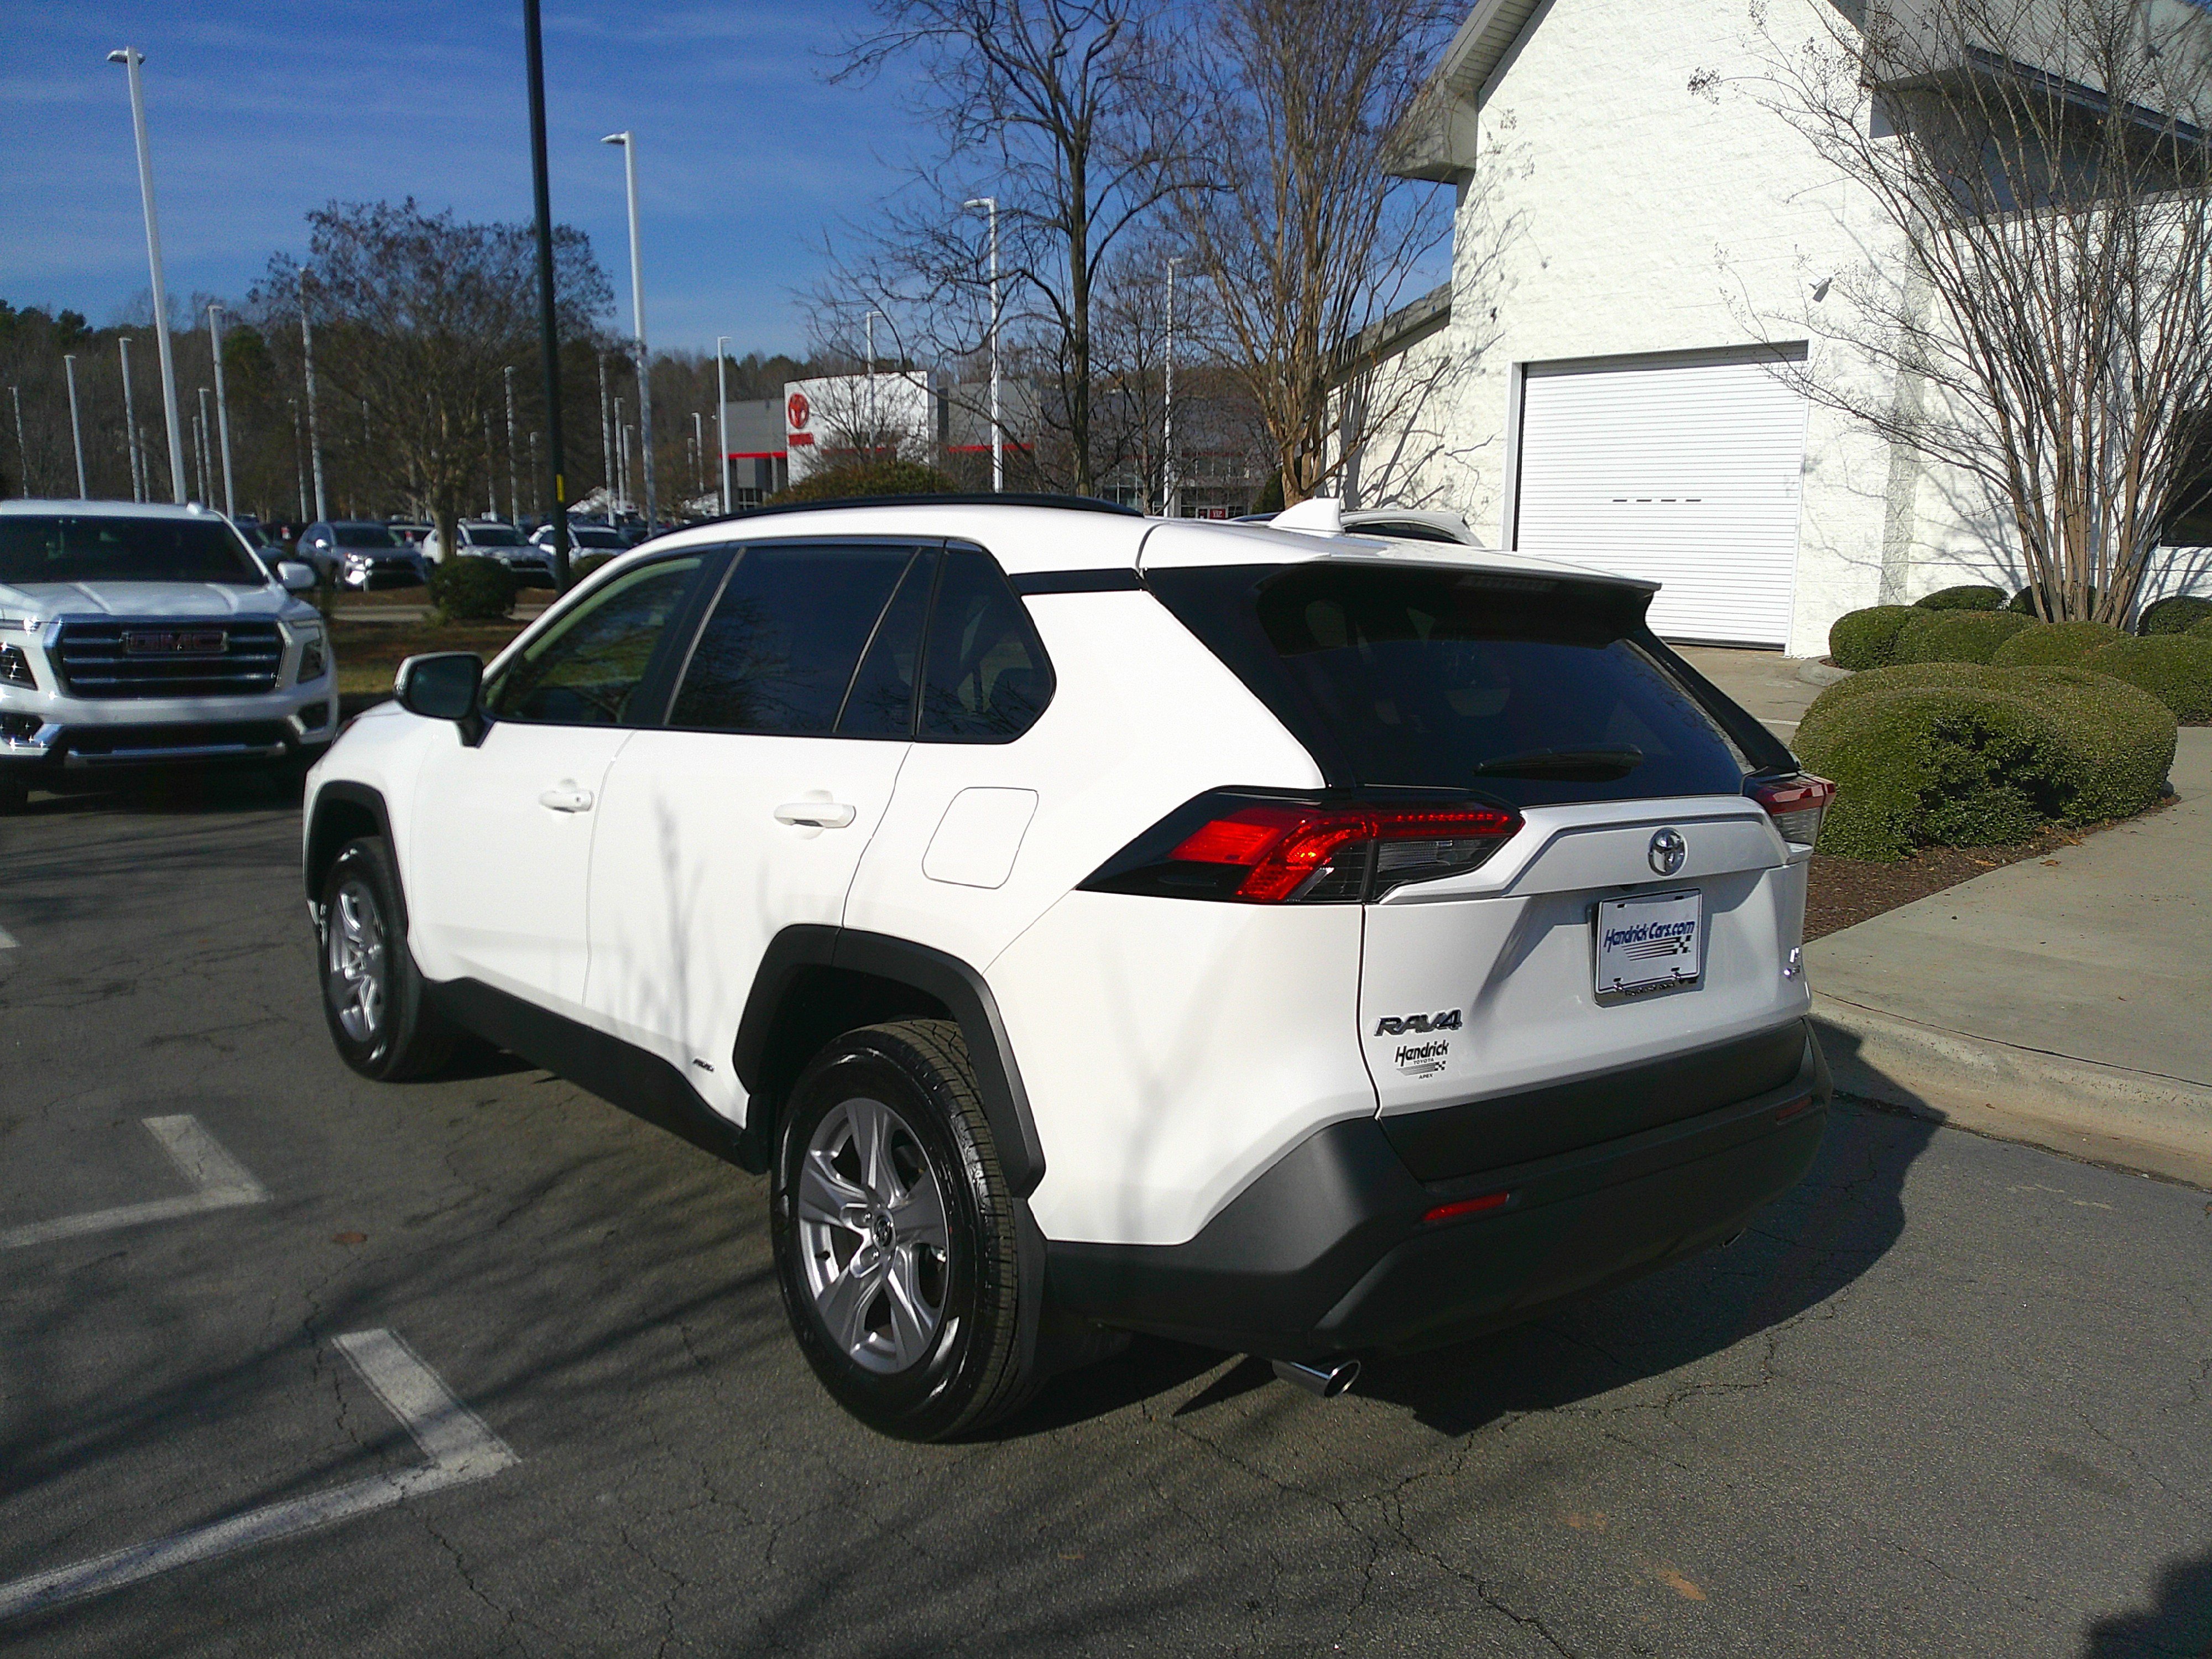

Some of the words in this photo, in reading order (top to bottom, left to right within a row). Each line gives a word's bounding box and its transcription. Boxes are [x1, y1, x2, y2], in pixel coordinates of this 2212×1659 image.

[131, 634, 221, 651] GMC
[1374, 1009, 1463, 1036] RAV4
[1395, 1040, 1449, 1067] Hendrick
